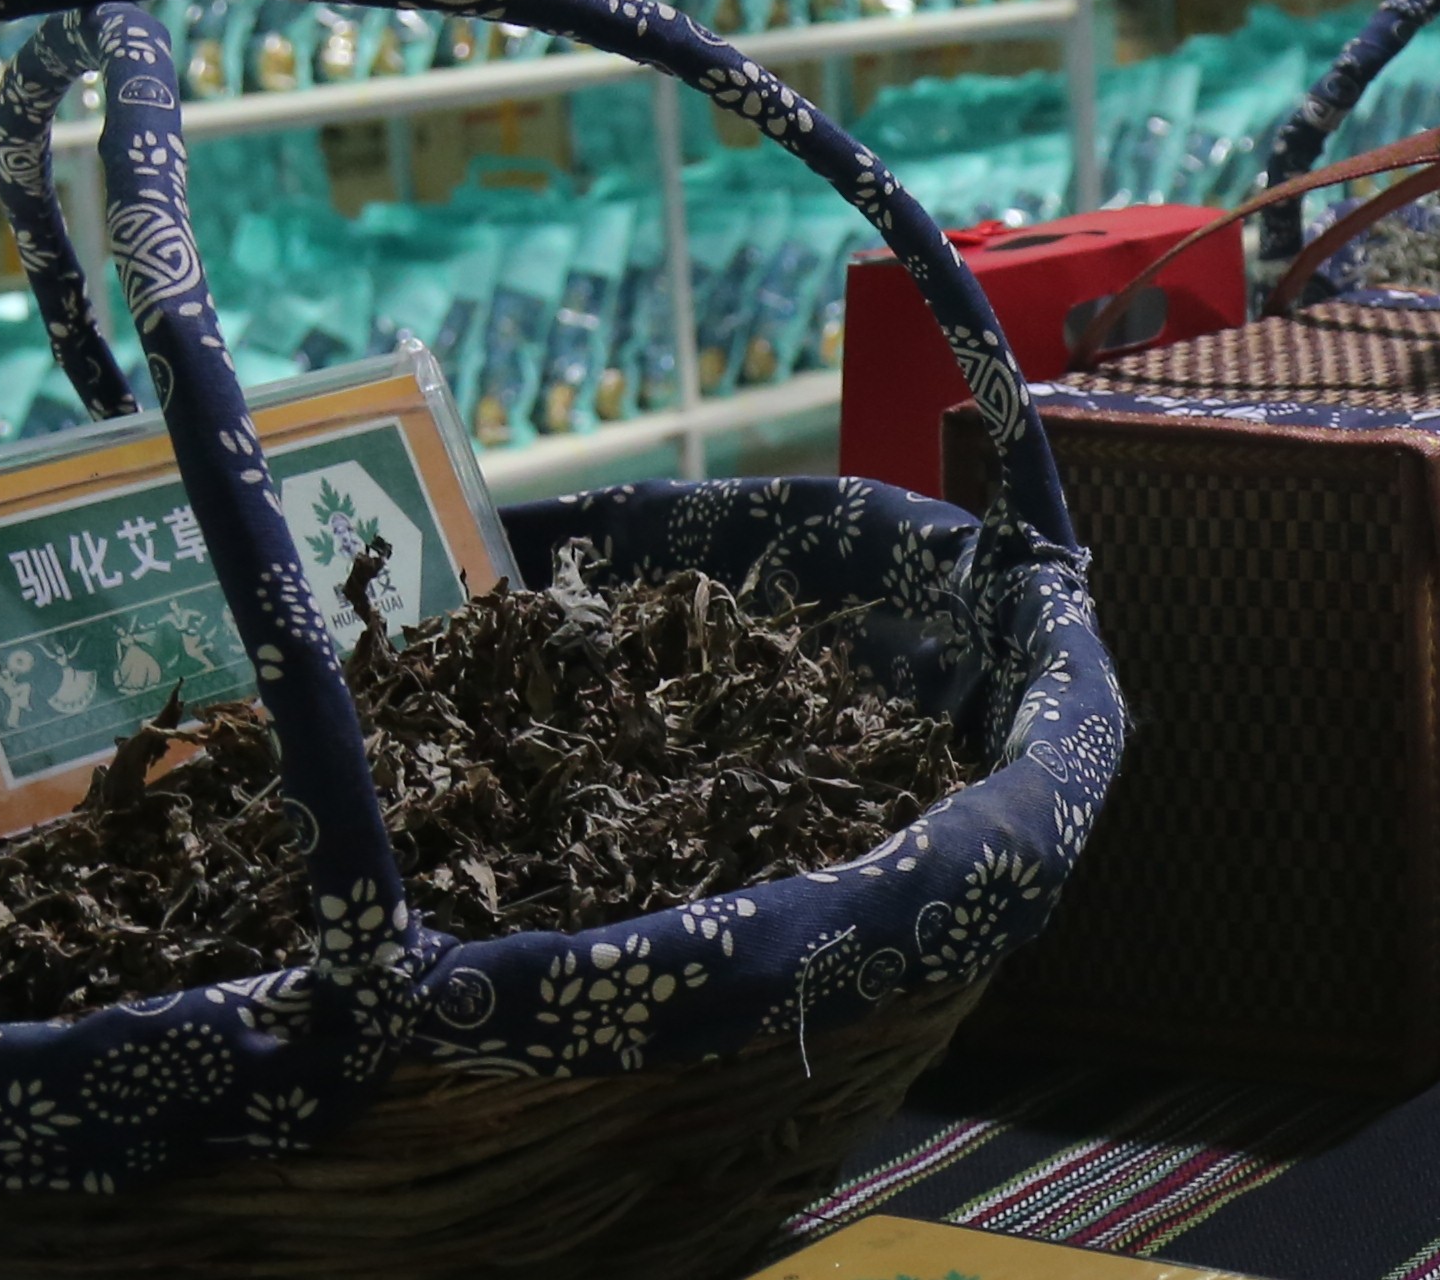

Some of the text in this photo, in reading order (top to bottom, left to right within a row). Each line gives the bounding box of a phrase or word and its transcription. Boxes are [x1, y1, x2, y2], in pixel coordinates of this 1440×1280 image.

[7, 504, 210, 608] 驯化艾草
[331, 595, 404, 630] HUAUAI
